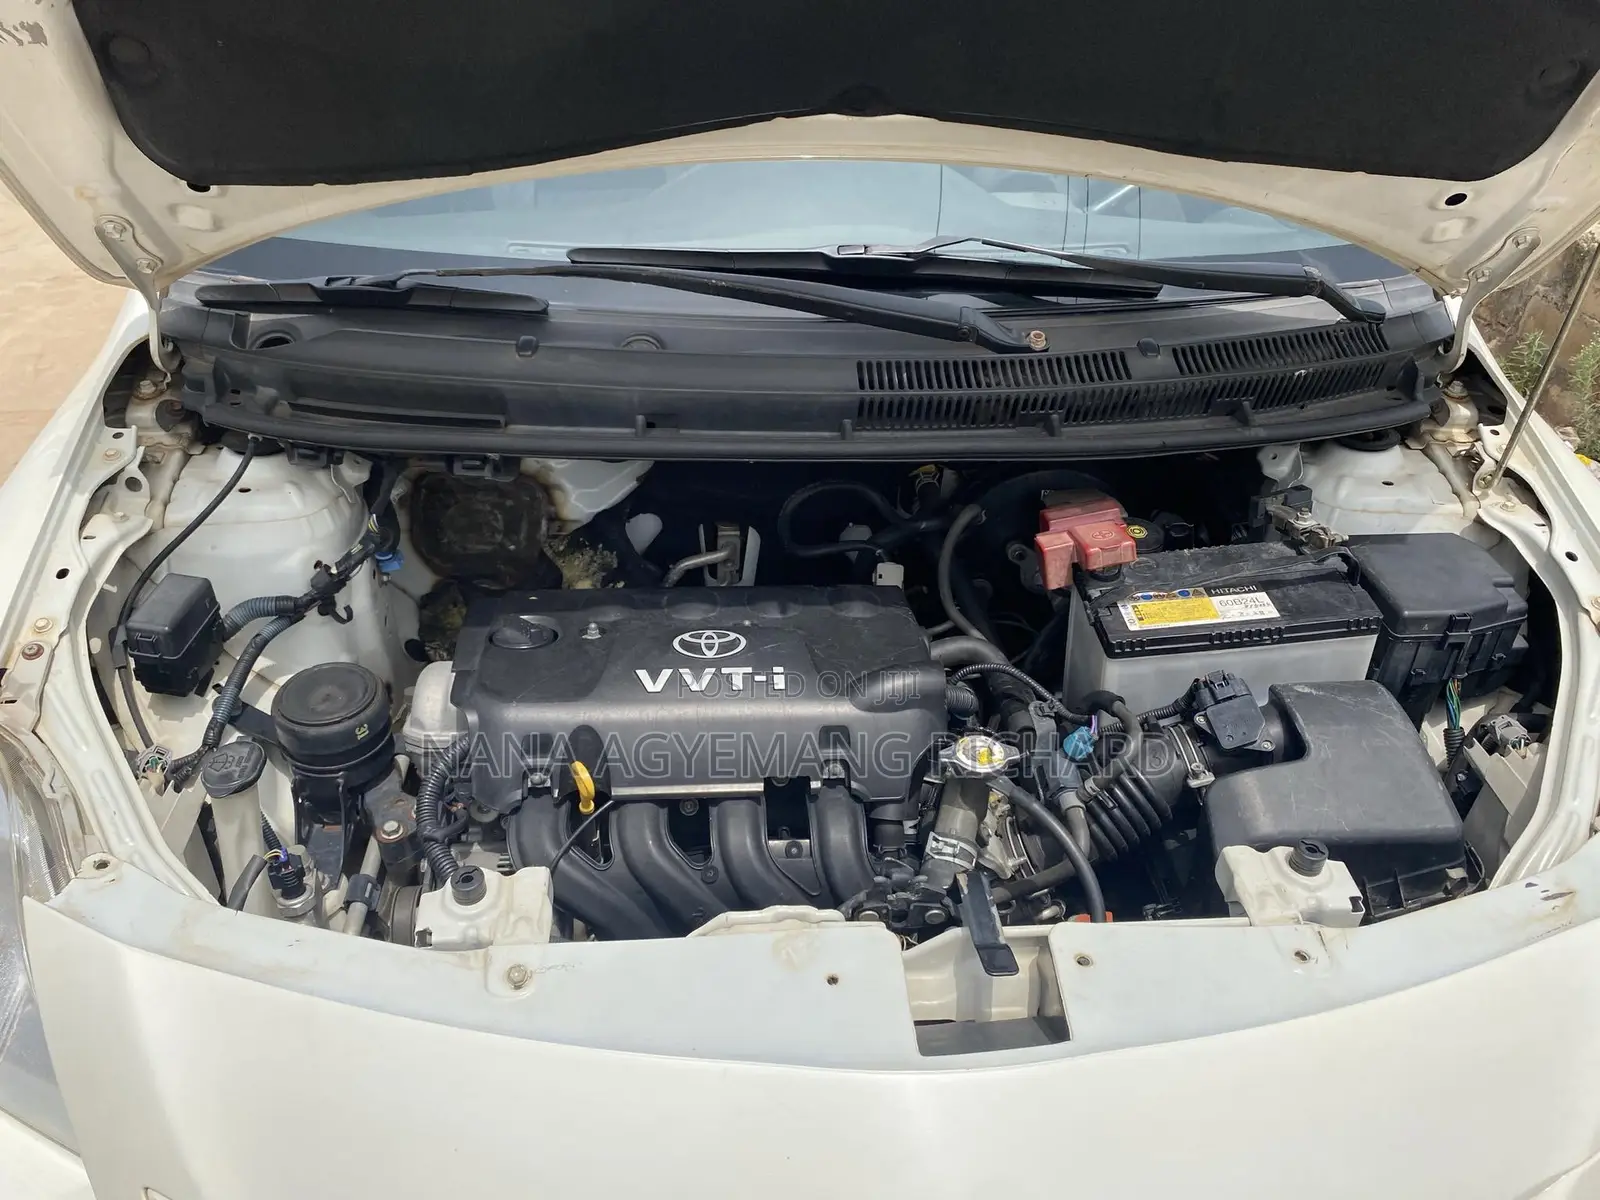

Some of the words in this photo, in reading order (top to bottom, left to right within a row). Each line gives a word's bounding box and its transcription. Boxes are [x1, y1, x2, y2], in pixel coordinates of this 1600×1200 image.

[1211, 585, 1257, 595] HITACHI
[1218, 596, 1264, 607] 60B24L
[635, 666, 785, 693] VVT-i
